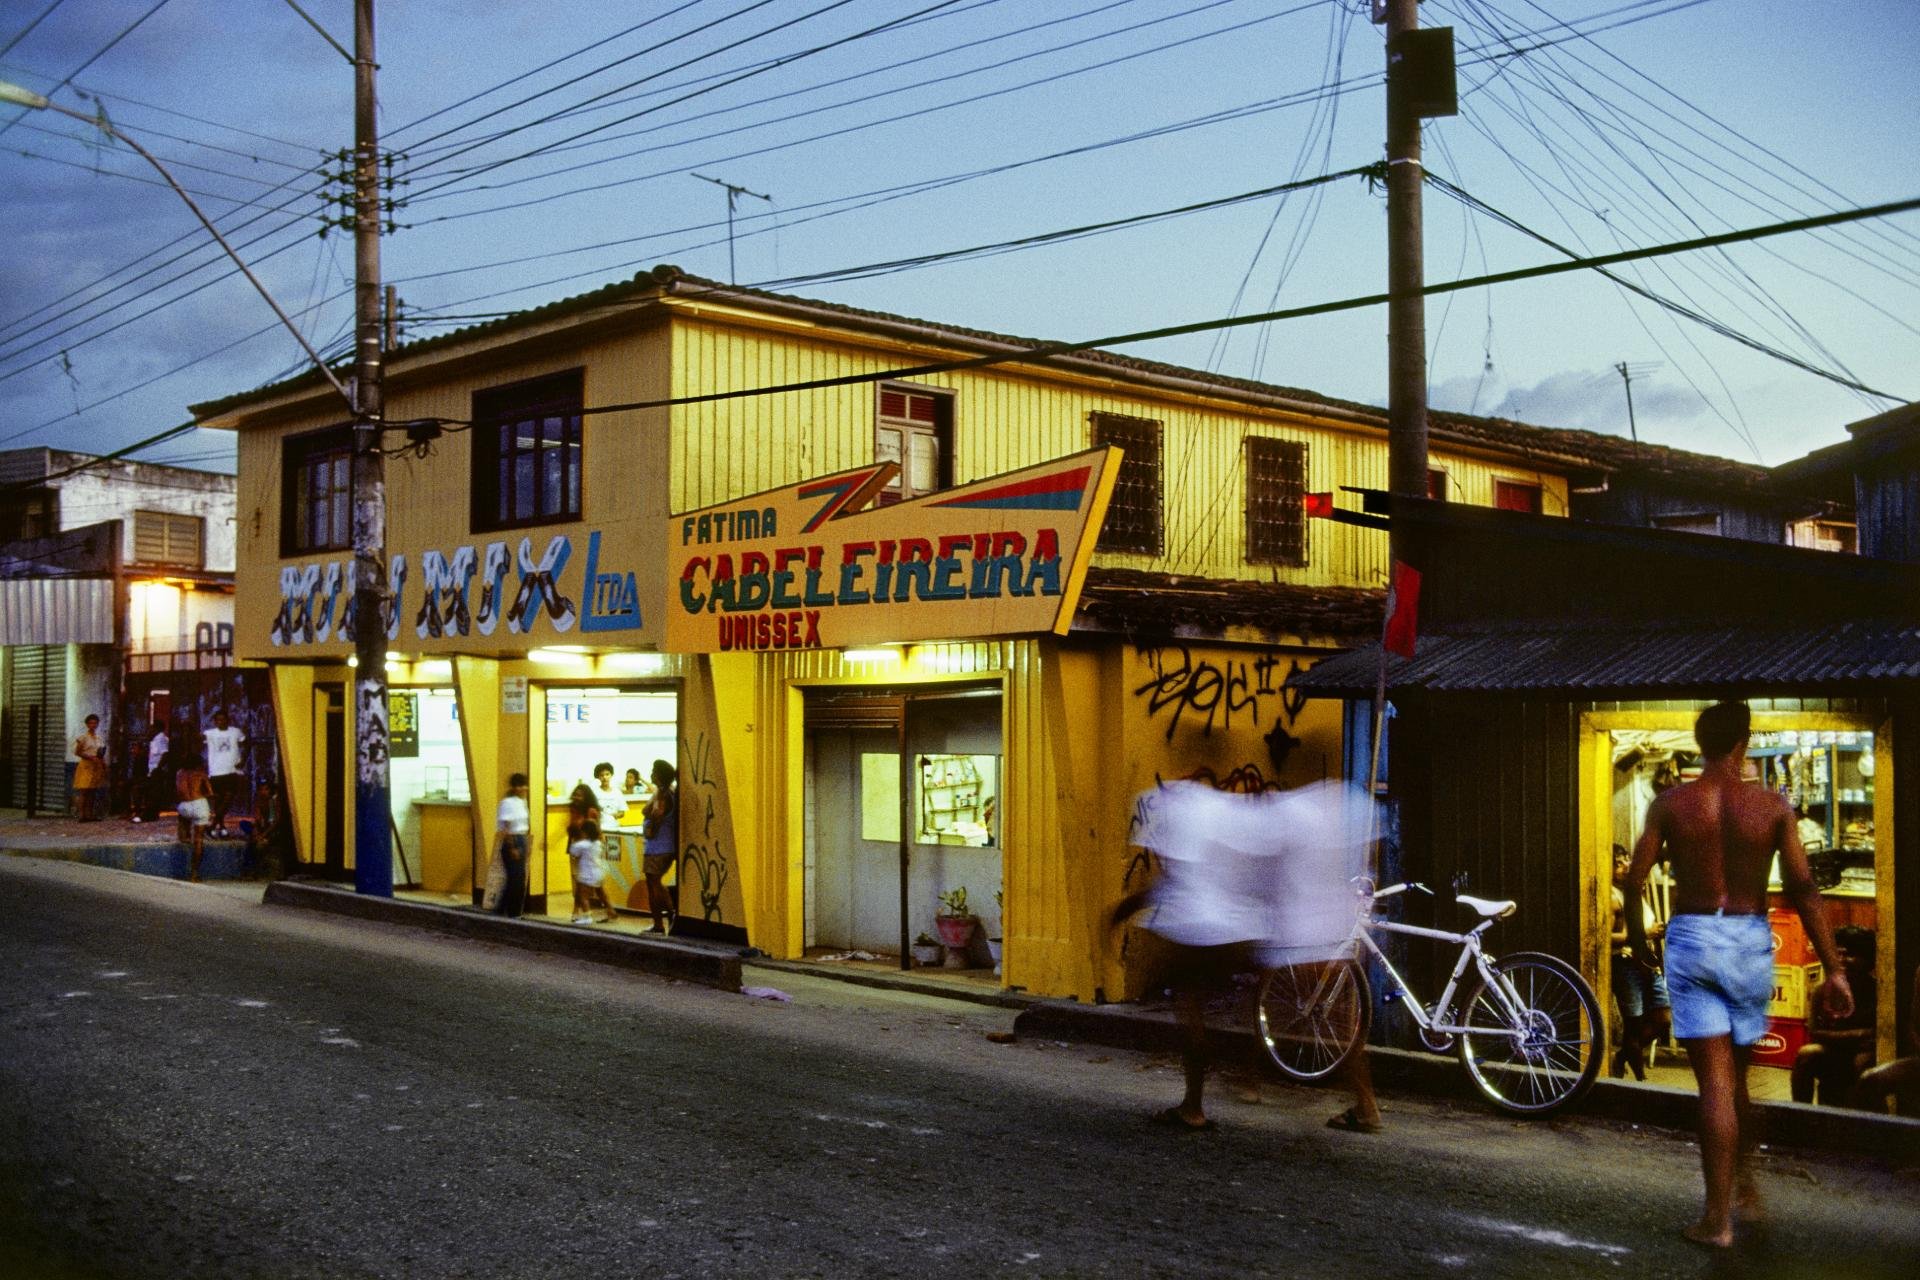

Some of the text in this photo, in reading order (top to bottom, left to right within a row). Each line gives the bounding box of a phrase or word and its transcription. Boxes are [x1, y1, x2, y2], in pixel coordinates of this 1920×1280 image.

[415, 534, 577, 640] MIX
[679, 528, 1062, 615] CABELEIREIRA
[718, 610, 821, 651] UNISSEX
